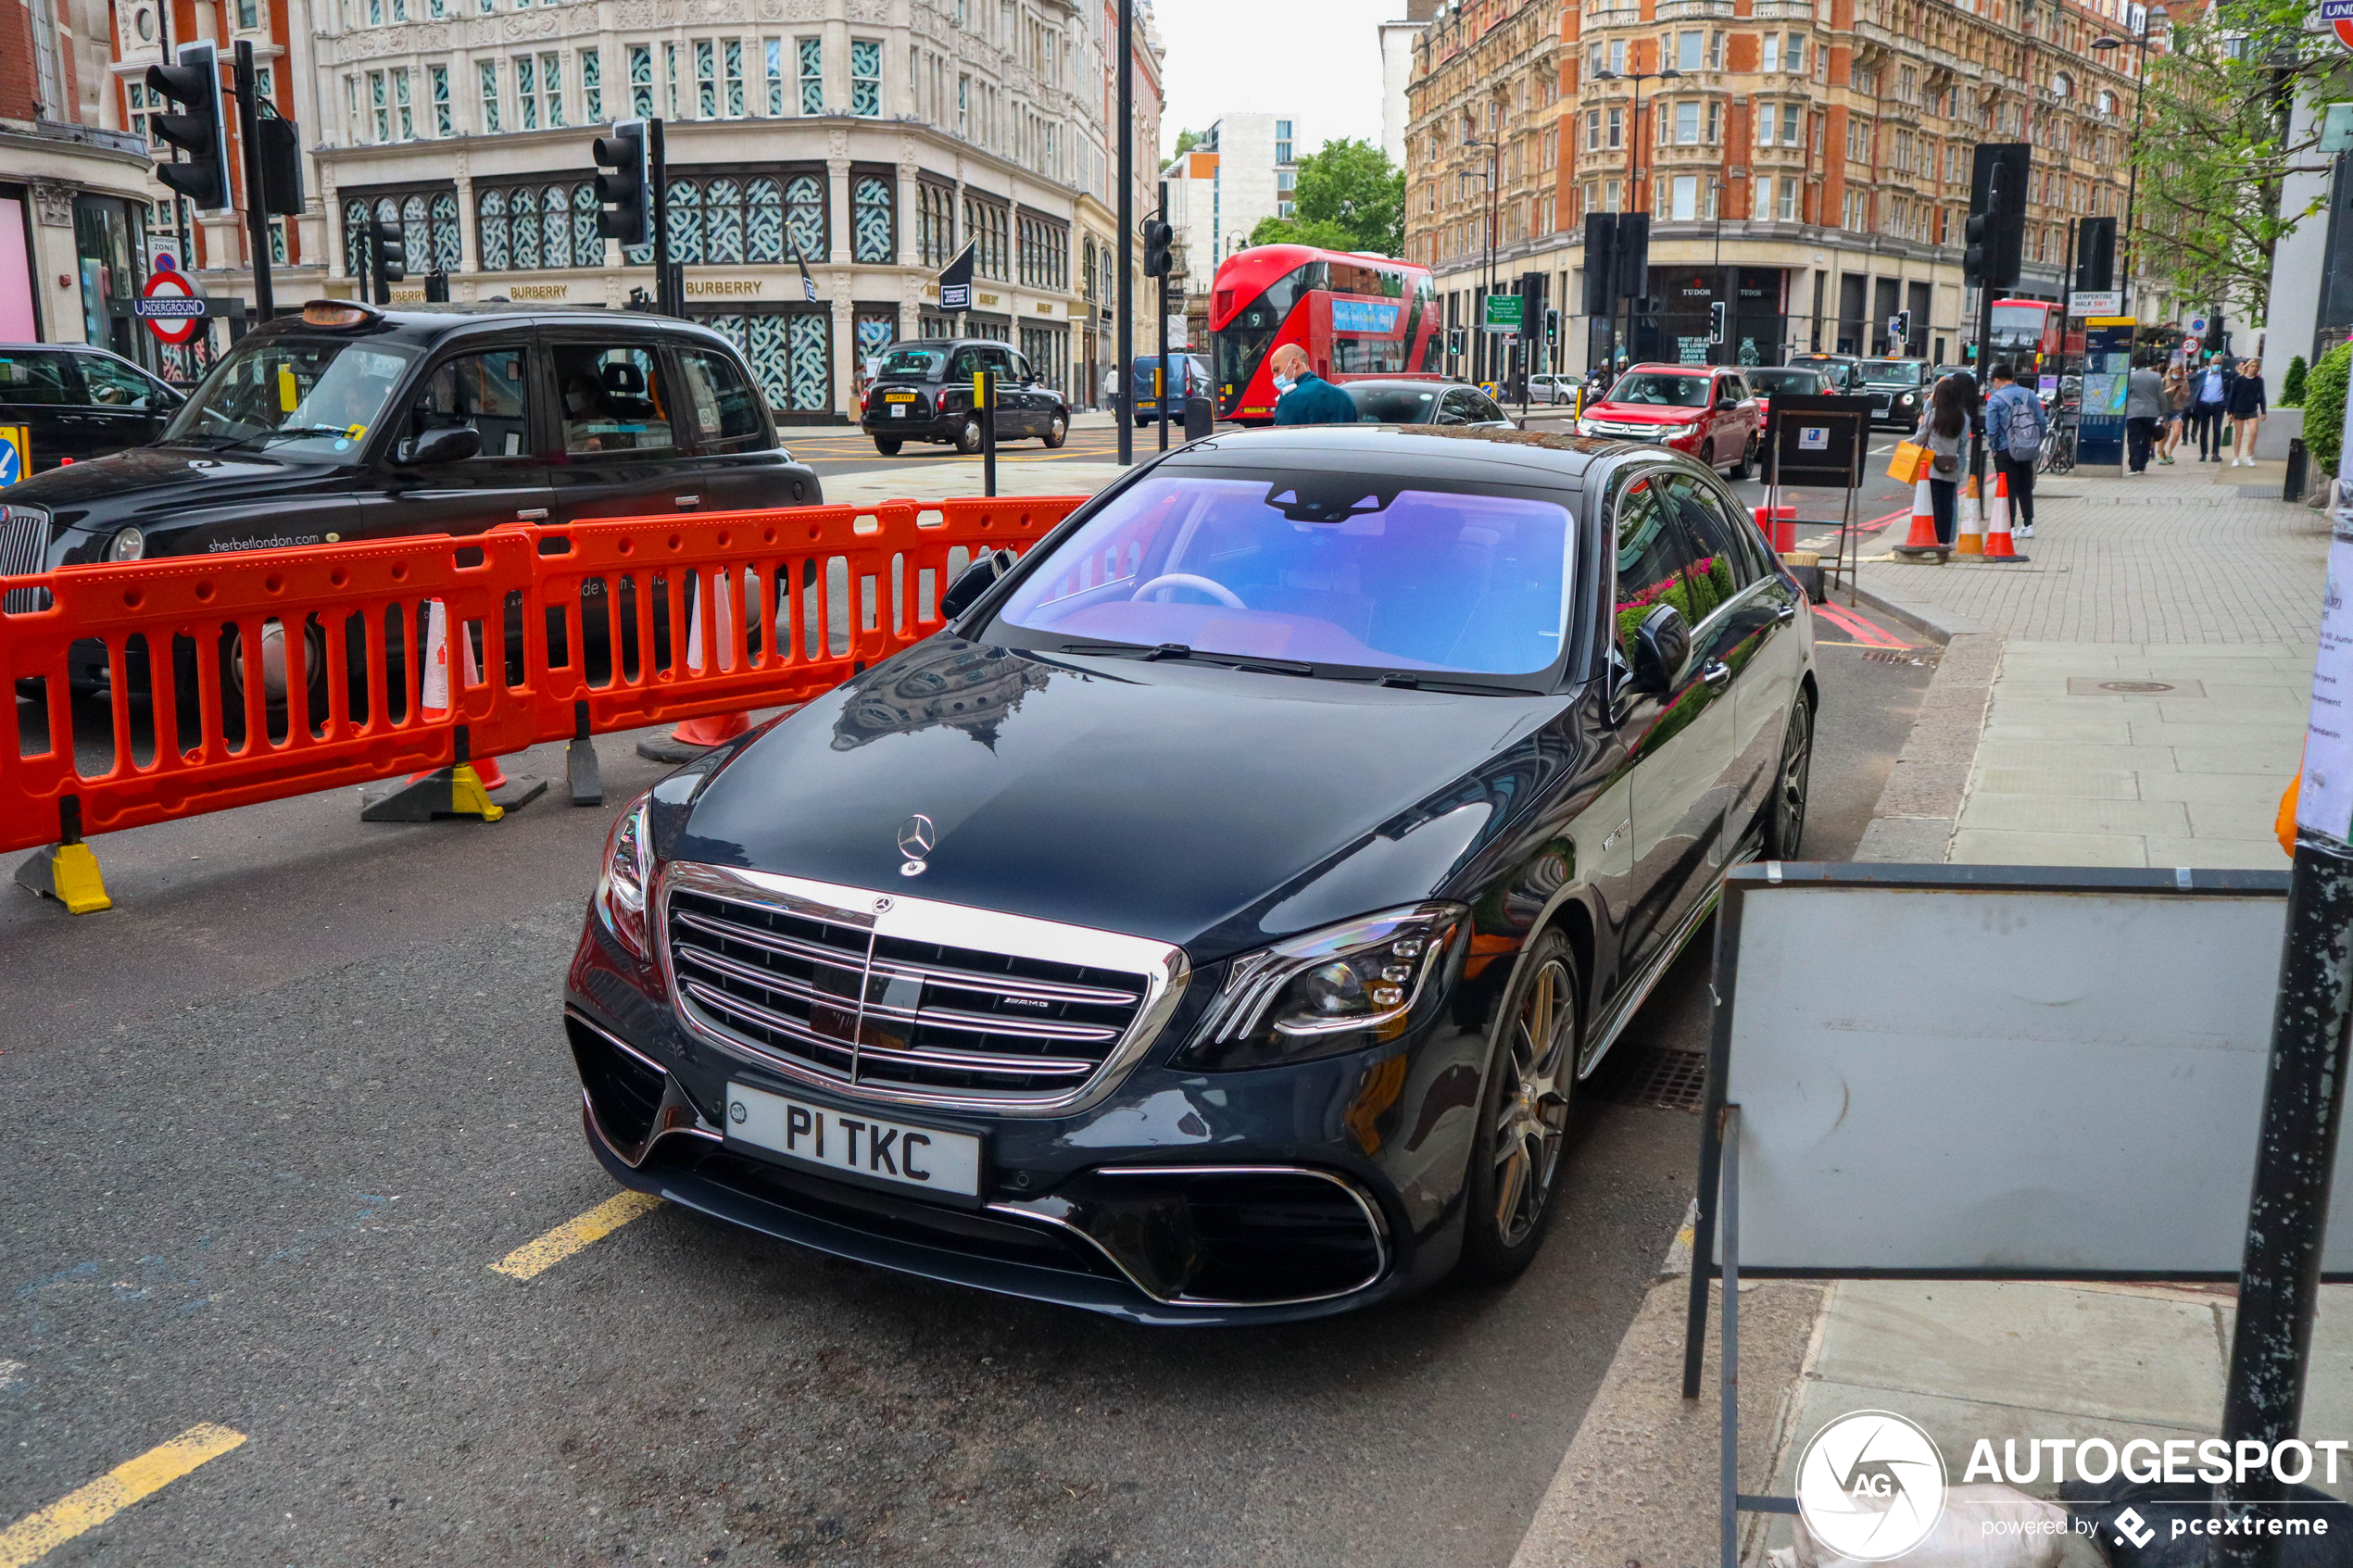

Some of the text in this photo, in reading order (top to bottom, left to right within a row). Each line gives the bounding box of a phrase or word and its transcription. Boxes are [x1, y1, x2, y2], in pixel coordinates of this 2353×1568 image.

[149, 235, 178, 244] Controlled
[510, 284, 568, 298] BURBERRY
[686, 281, 762, 295] BURBERRY
[133, 299, 205, 316] UNDERGROUND
[1252, 313, 1261, 326] 9
[2023, 337, 2034, 345] 23
[208, 533, 320, 553] sherbetlondon.com
[2334, 634, 2353, 645] June
[2321, 675, 2337, 684] rank
[1016, 998, 1049, 1009] AMG
[786, 1104, 931, 1181] P1 TKC
